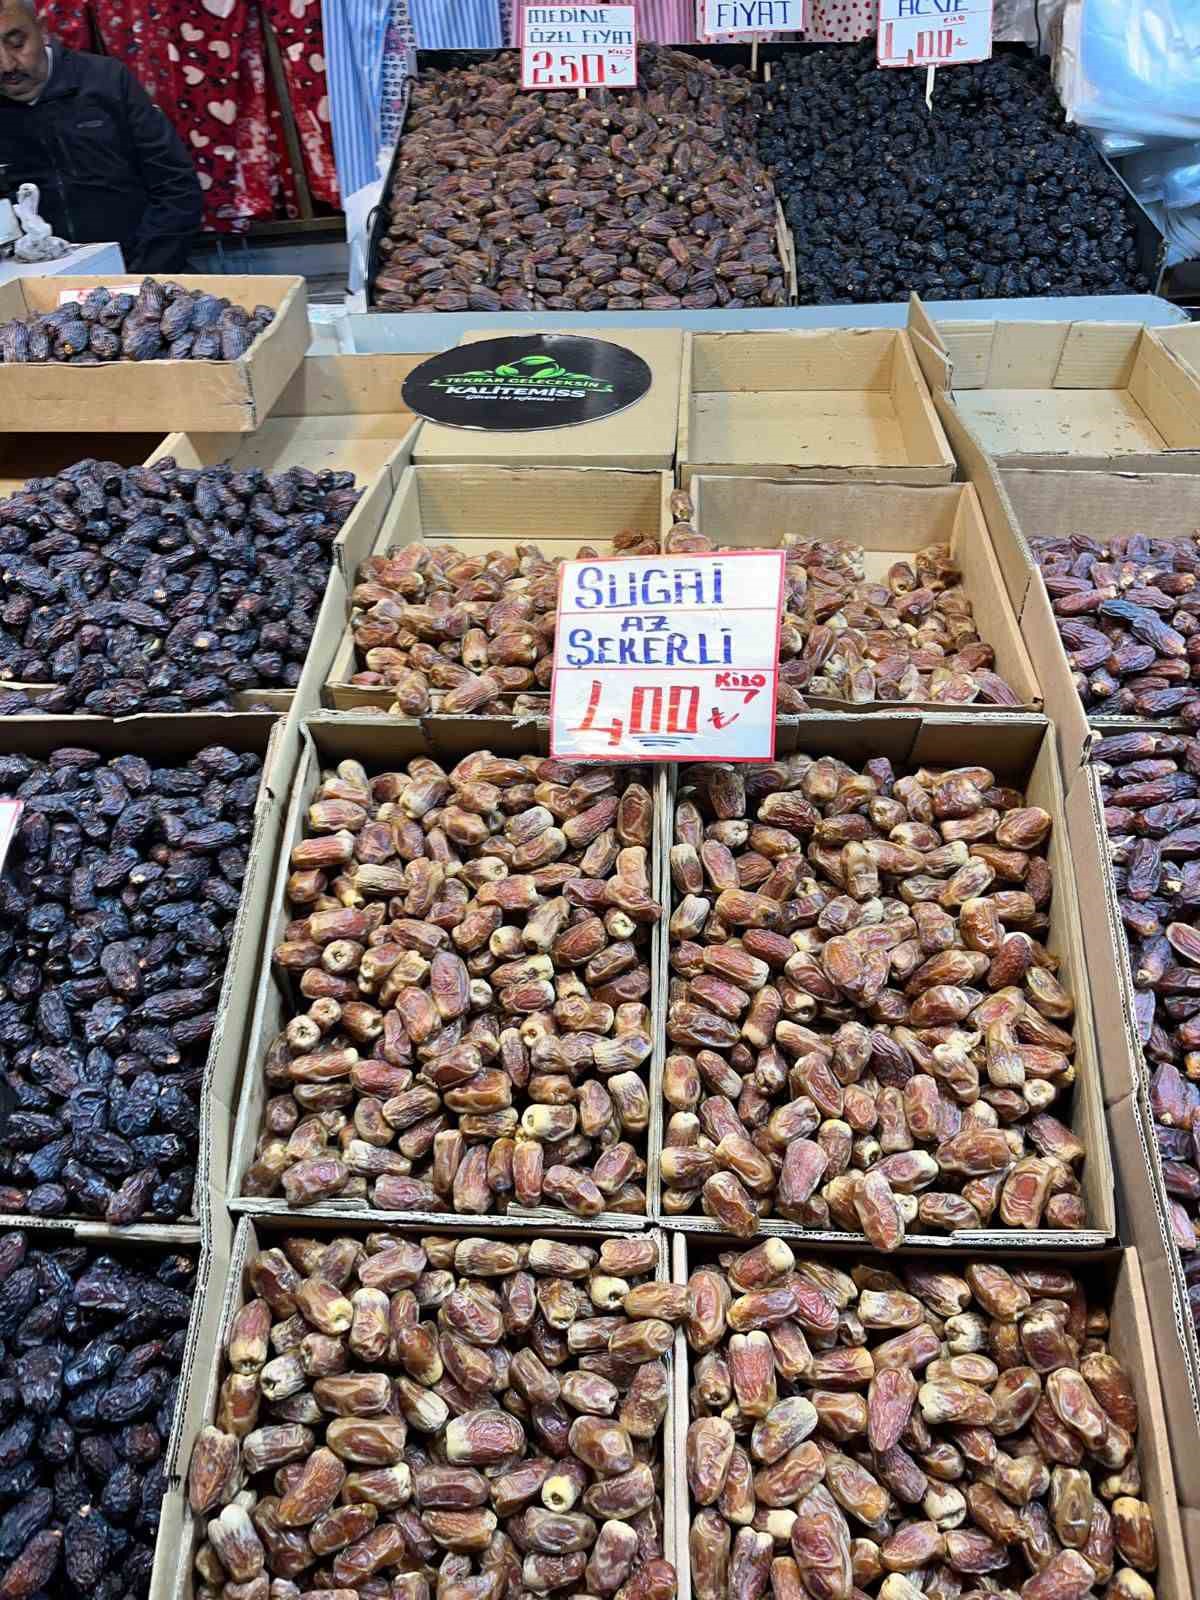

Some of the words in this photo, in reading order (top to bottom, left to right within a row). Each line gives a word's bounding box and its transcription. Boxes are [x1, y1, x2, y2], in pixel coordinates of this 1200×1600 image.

[717, 0, 791, 27] FİYAT
[530, 27, 577, 43] ÖZEL
[582, 30, 633, 44] FİYAT
[532, 51, 606, 84] 250
[621, 615, 671, 633] AZ
[566, 627, 733, 669] ŞEKERLİ
